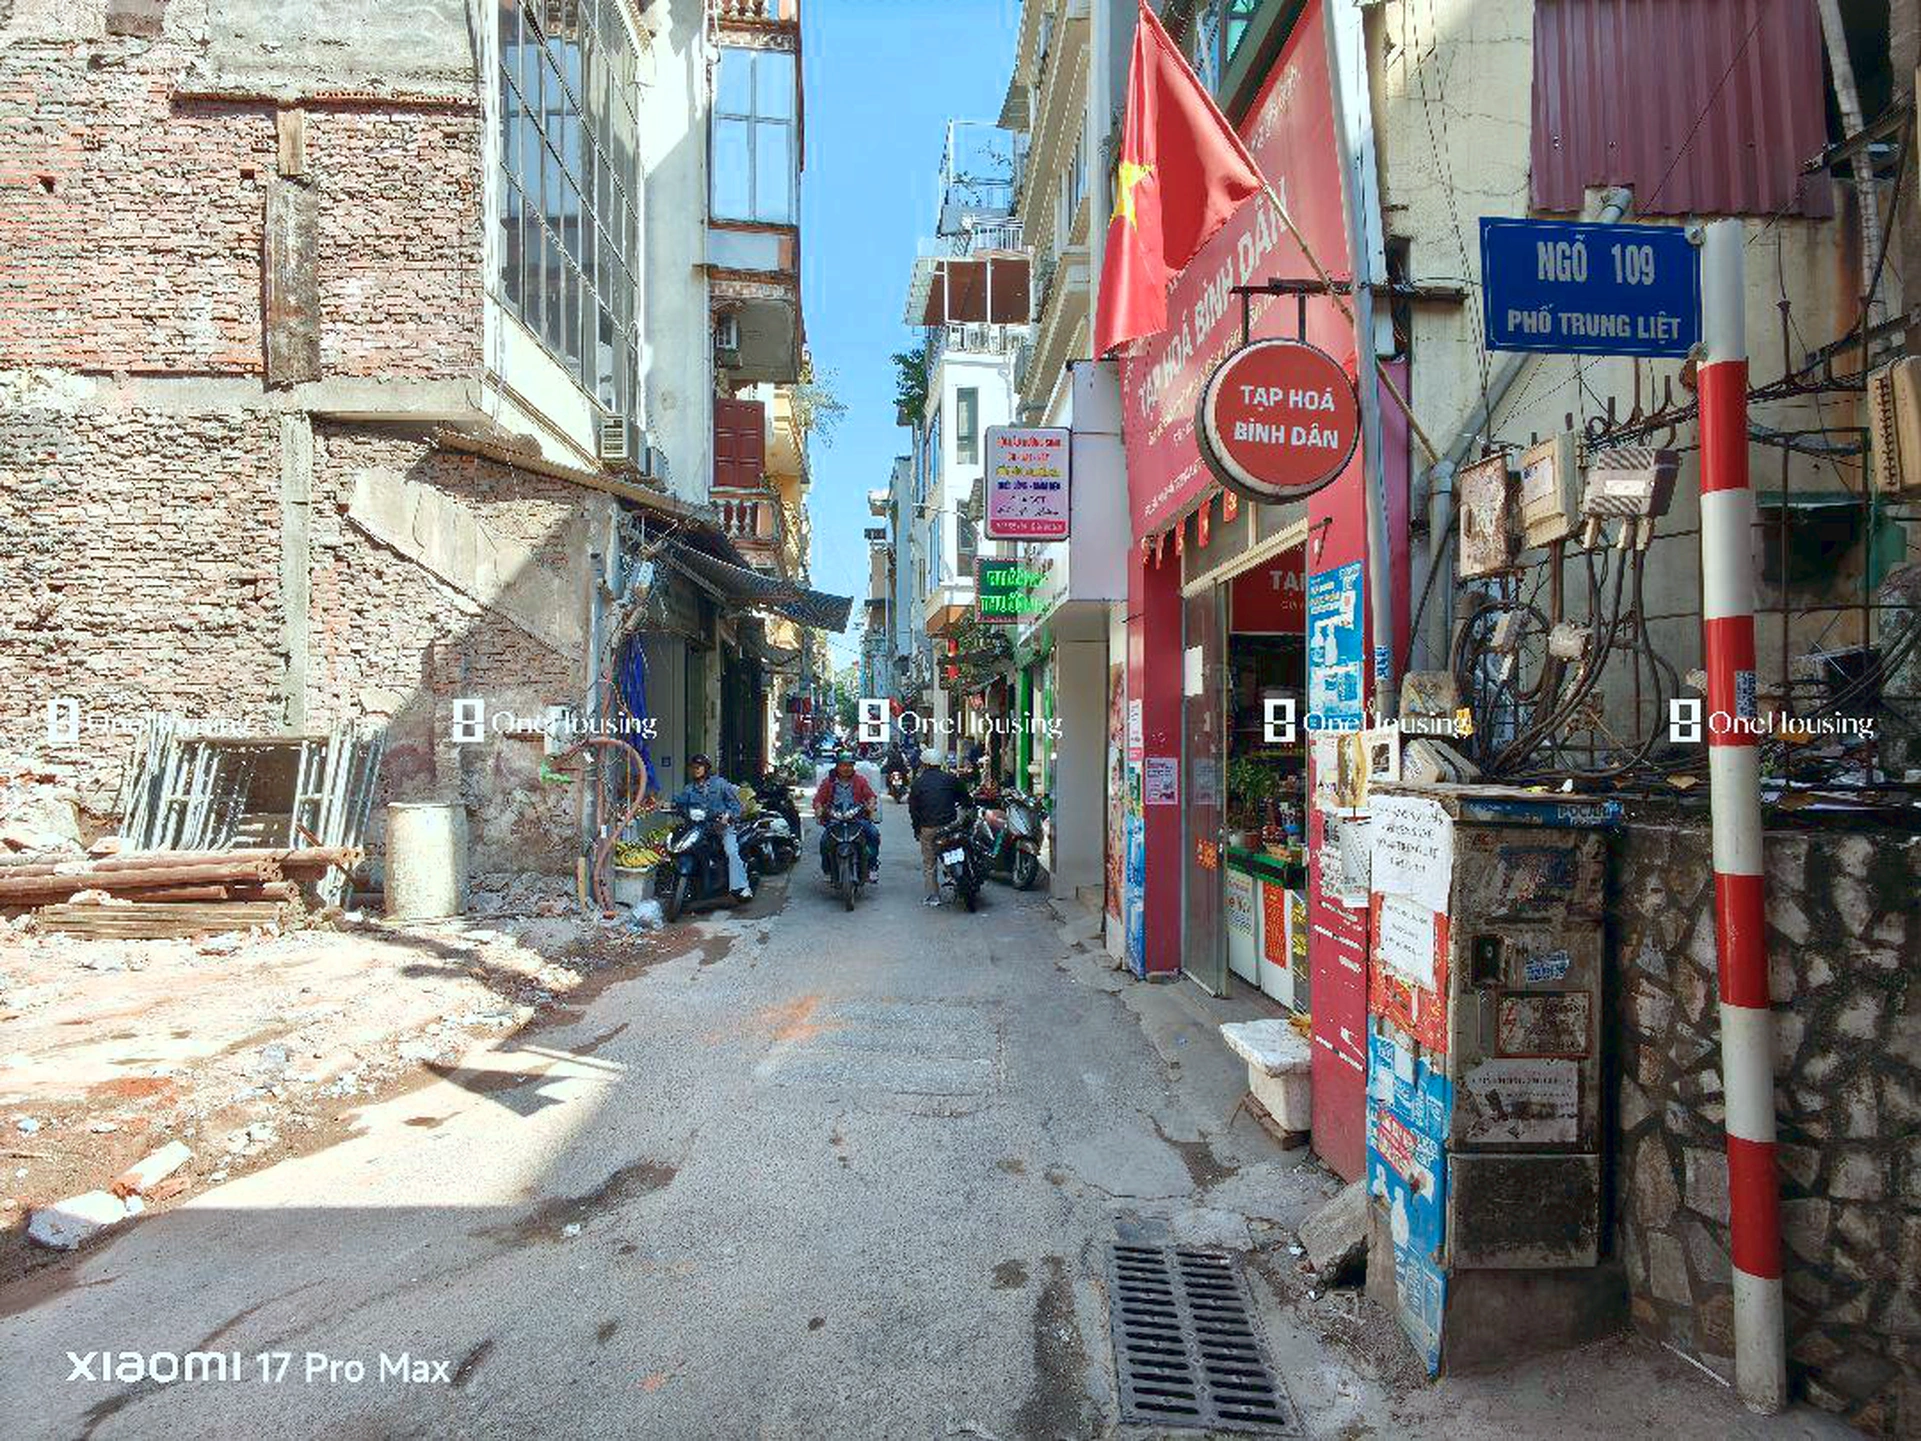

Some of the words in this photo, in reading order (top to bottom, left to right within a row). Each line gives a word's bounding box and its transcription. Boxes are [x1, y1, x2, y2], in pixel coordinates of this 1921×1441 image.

[1536, 233, 1588, 283] NGÕ
[1611, 243, 1655, 286] 109
[1507, 303, 1553, 335] PHỐ
[1558, 311, 1630, 338] TRUNG
[1637, 310, 1682, 345] LIỆT
[1240, 385, 1283, 411] TẠP
[1288, 387, 1336, 412] HOÁ
[1233, 417, 1285, 444] BÌNH
[1290, 422, 1339, 449] DÂN
